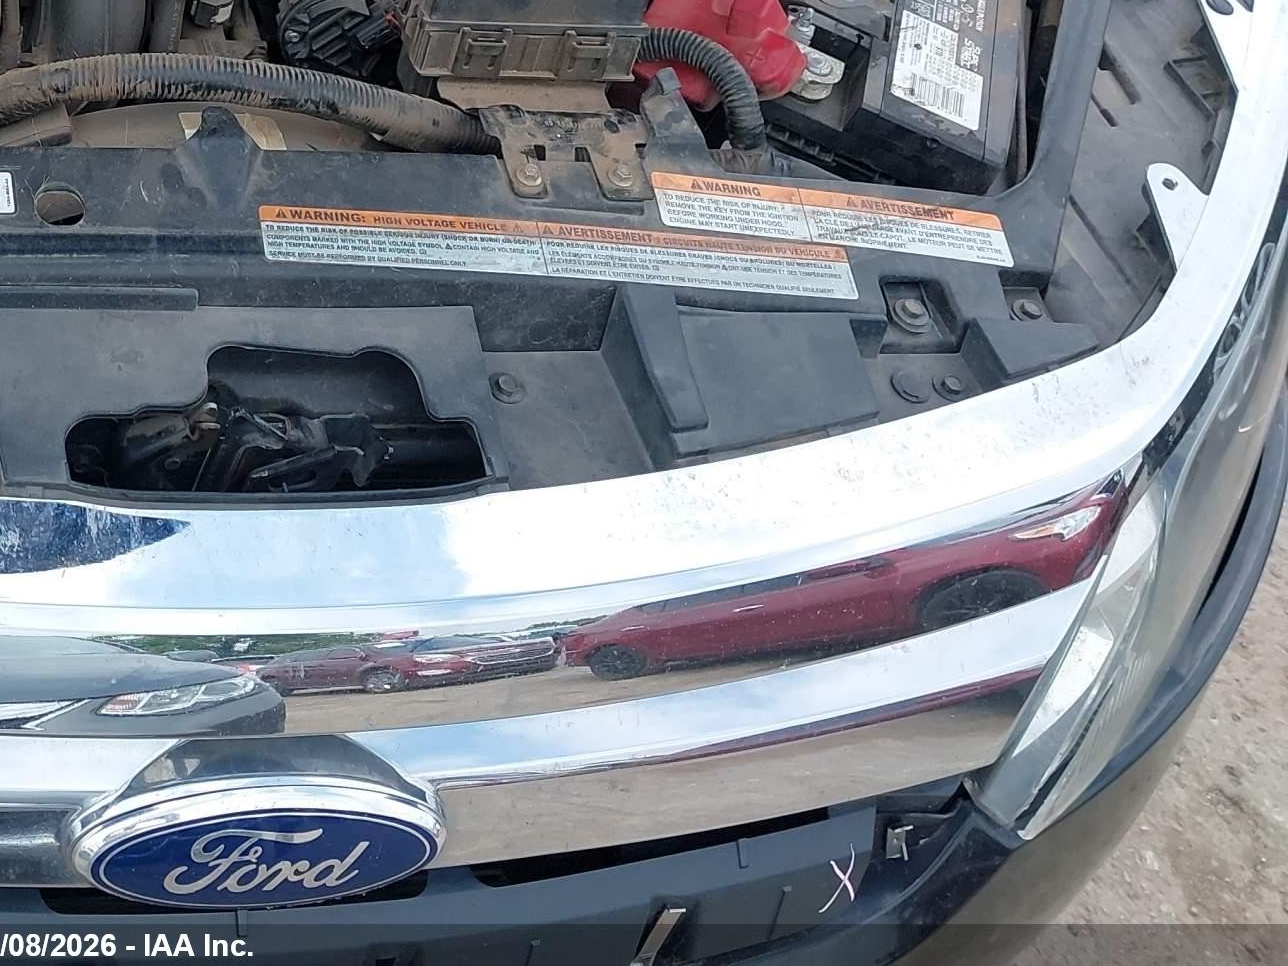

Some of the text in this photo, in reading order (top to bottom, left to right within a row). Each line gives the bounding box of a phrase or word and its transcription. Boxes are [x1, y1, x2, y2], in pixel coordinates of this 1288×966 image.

[701, 181, 761, 196] WARNING
[662, 192, 674, 200] TO
[674, 194, 705, 204] REDUCE
[706, 197, 721, 205] THE
[740, 201, 750, 209] OF
[860, 199, 955, 220] AVERTISSEMENT
[289, 209, 507, 231] WARNING: HIGH VOLTAGE VEHICLE
[664, 200, 696, 210] REMOVE
[729, 208, 750, 216] FROM
[752, 210, 766, 218] THE
[767, 212, 798, 221] IGNITION
[666, 208, 696, 217] BEFORE
[698, 212, 733, 221] WORKING
[734, 216, 759, 224] UNDER
[697, 219, 713, 227] MAY
[714, 221, 738, 230] START
[285, 241, 334, 249] TEMPERATURES
[557, 226, 653, 243] AVERTISSEMENT
[705, 240, 732, 250] HAUTE
[774, 246, 788, 254] DU
[163, 828, 371, 895] Ford
